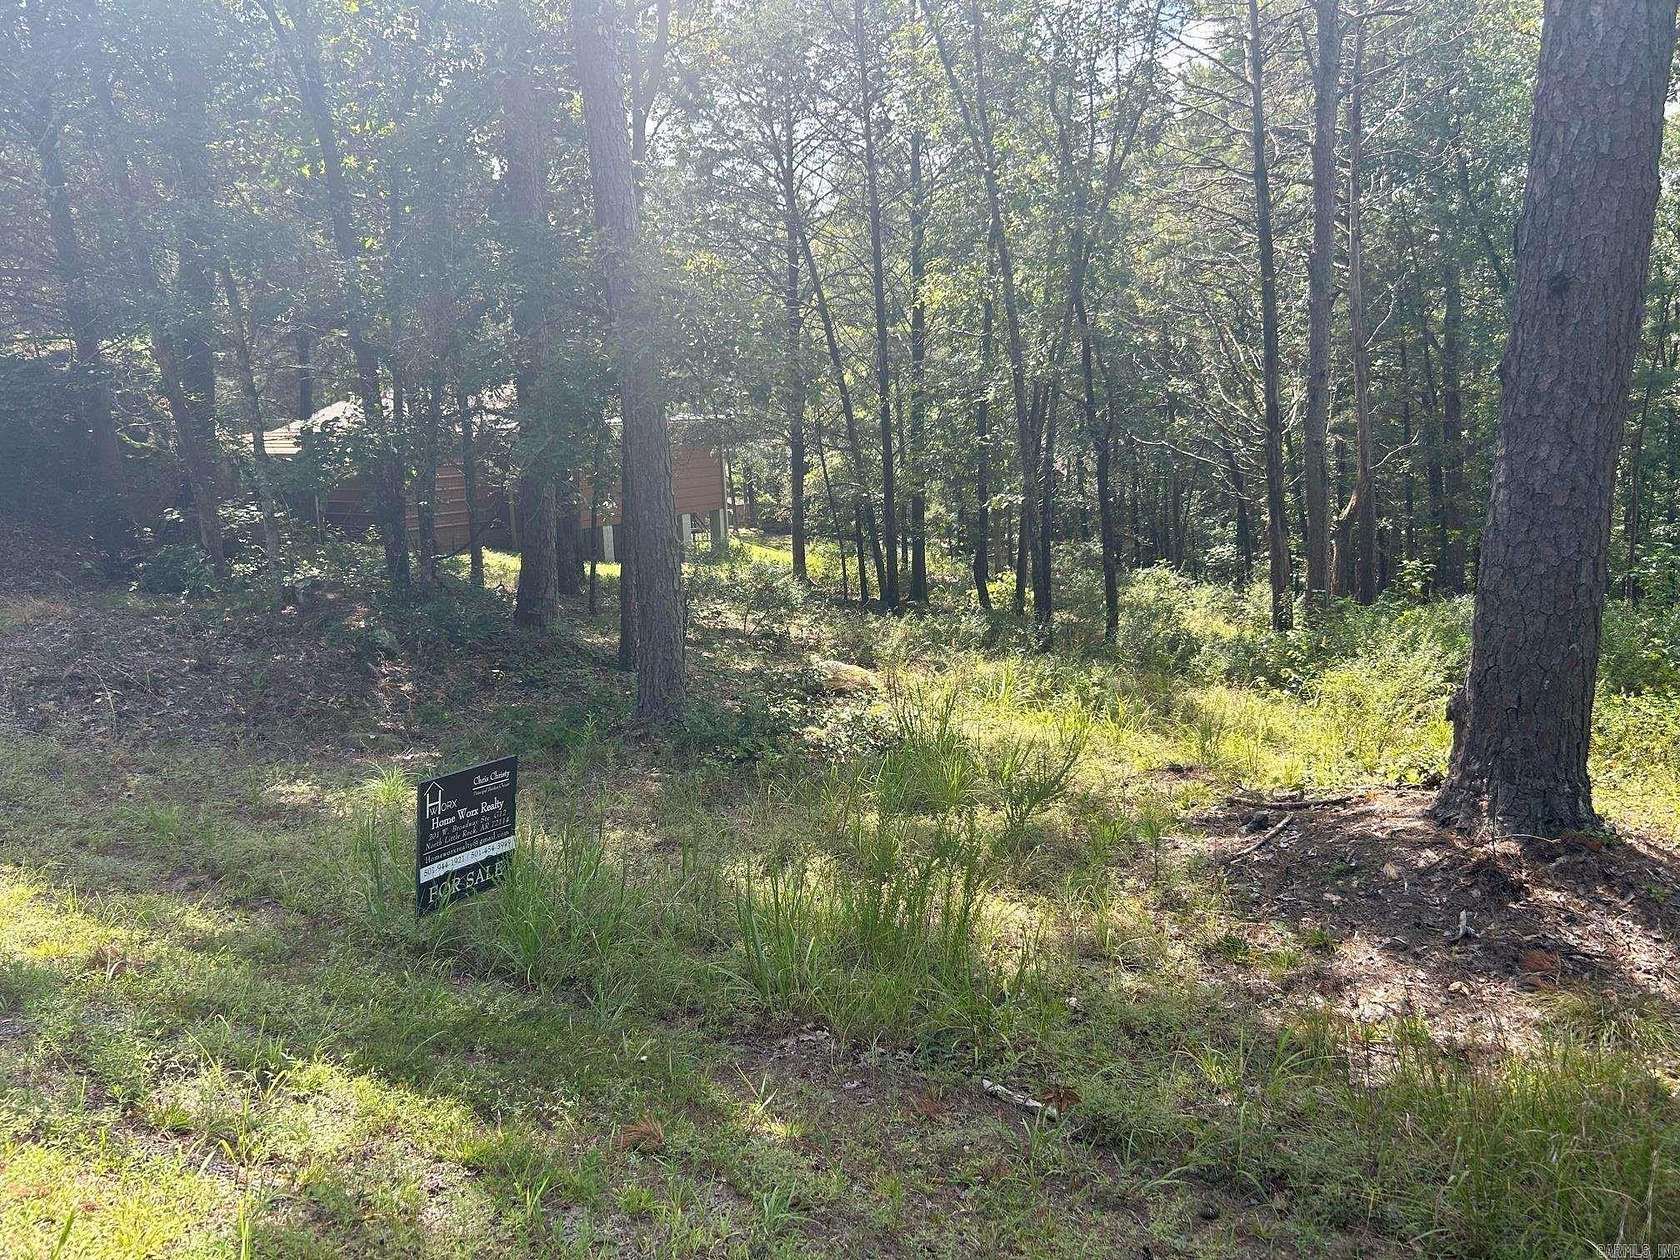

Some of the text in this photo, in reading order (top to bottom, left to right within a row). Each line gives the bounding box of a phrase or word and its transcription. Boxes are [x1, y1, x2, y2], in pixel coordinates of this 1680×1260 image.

[473, 775, 489, 785] Chris
[431, 797, 505, 830] Home Worx Realty
[425, 840, 443, 851] North
[444, 834, 460, 844] Little
[480, 823, 490, 831] AR
[428, 860, 504, 904] FOR SALE
